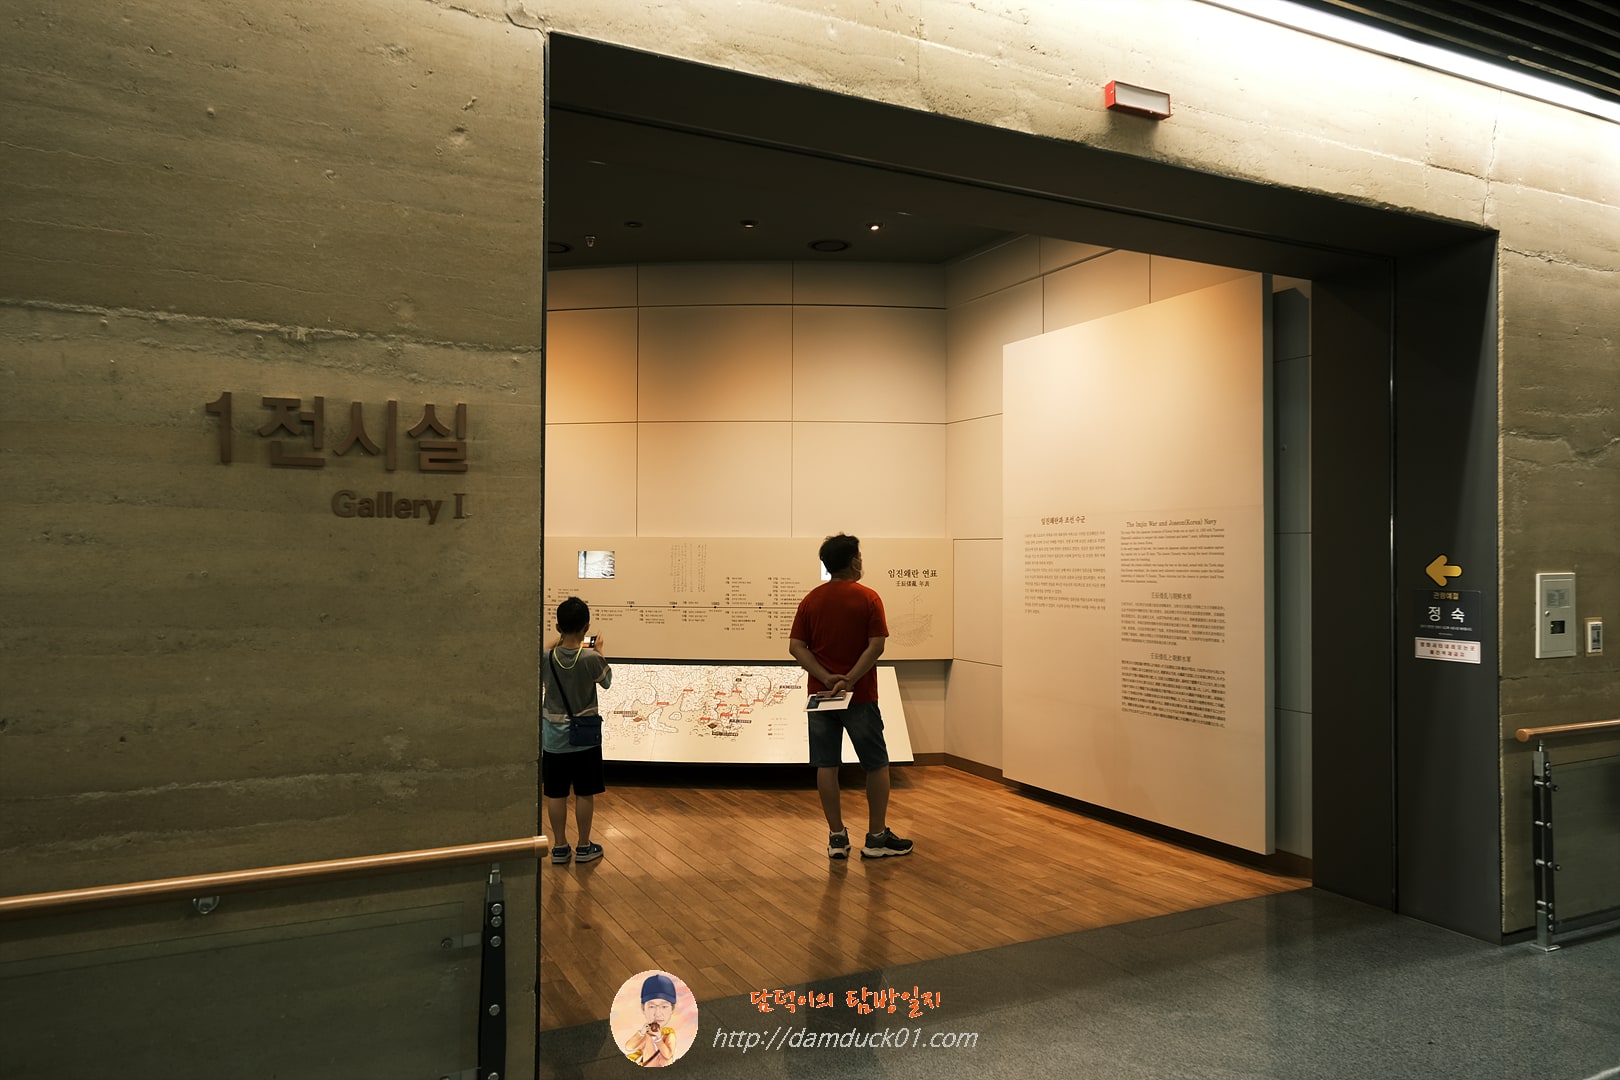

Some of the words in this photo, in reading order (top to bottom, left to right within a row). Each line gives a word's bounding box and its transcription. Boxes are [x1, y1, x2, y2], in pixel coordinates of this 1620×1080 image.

[331, 489, 443, 525] Gallery
[1203, 518, 1217, 526] Navy
[888, 569, 919, 578] 임진왜란
[922, 569, 938, 578] 연표
